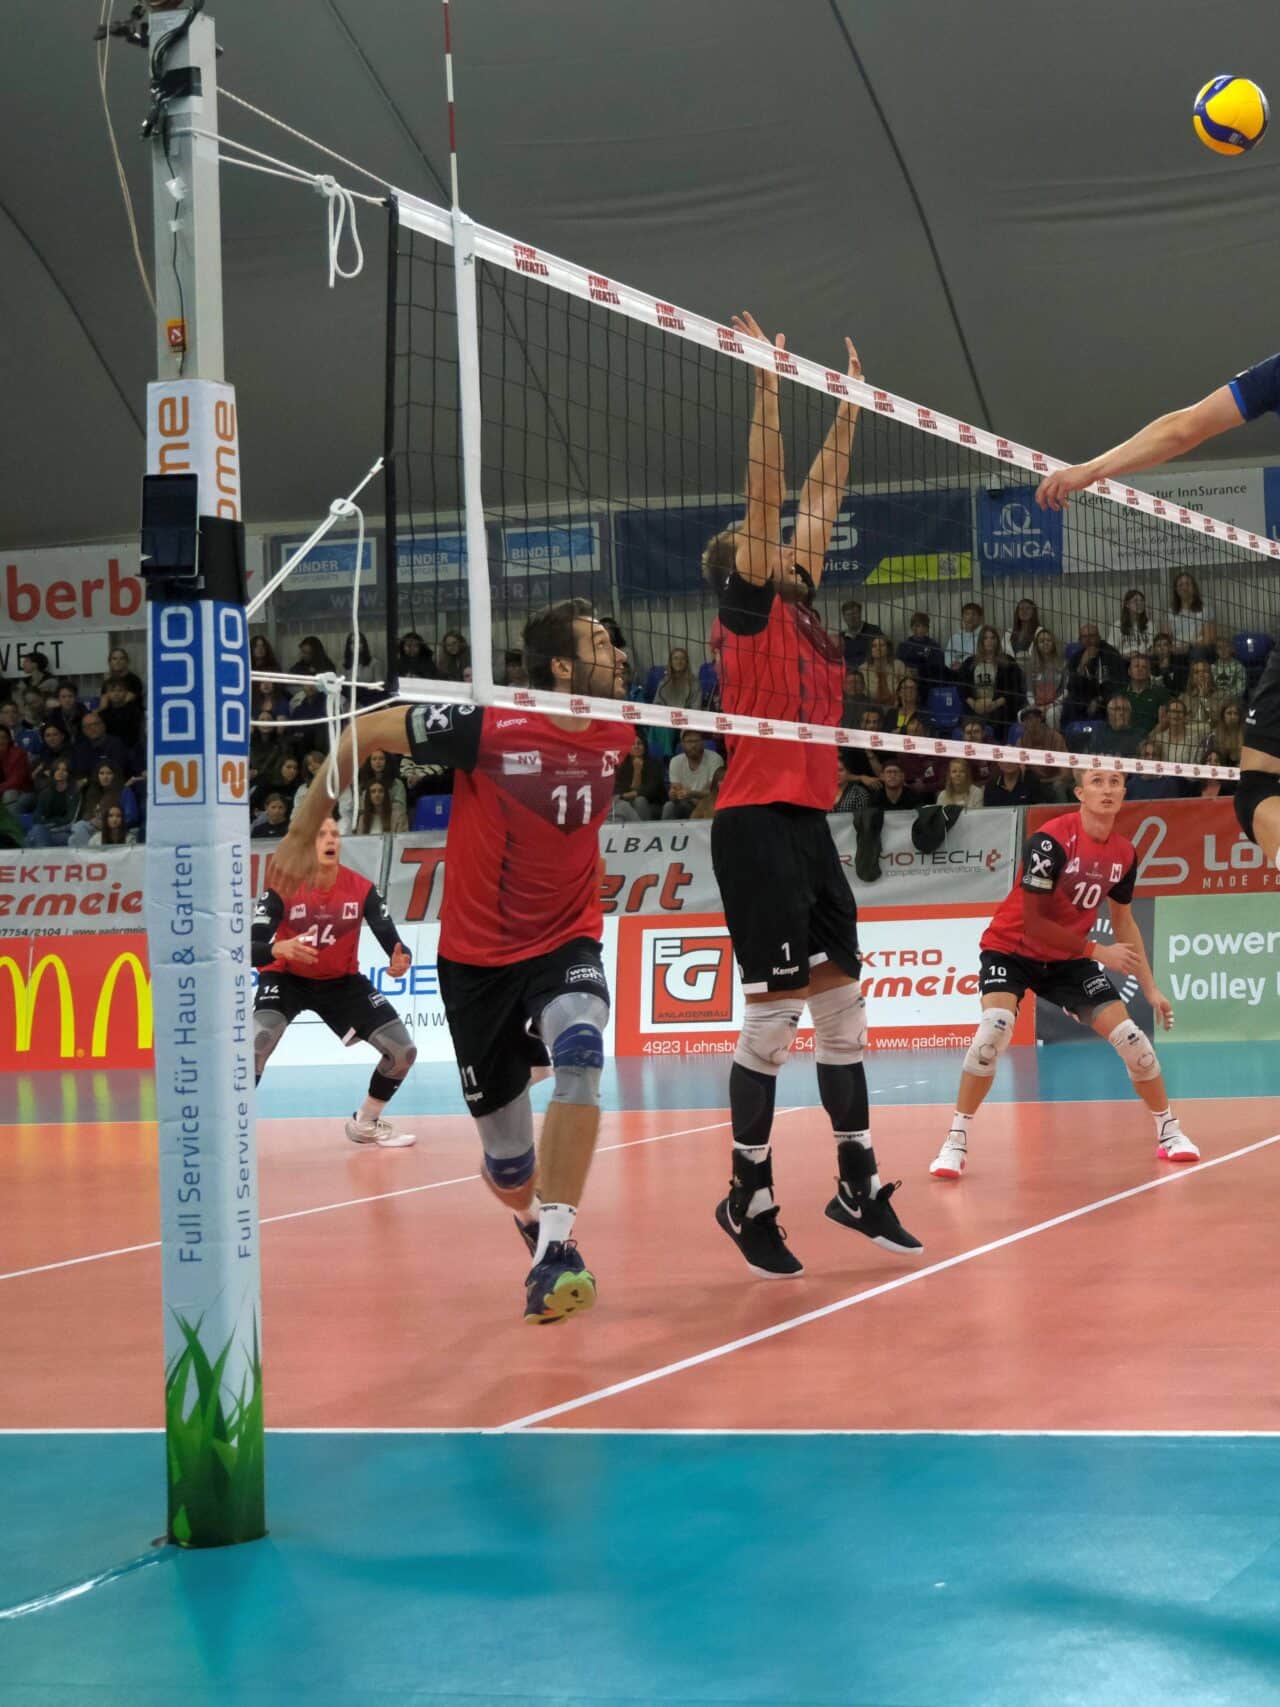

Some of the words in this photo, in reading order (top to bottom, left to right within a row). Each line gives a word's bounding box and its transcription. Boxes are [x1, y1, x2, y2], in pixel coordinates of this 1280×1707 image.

[158, 396, 190, 475] me
[214, 400, 238, 522] ome
[1177, 484, 1248, 498] InnSurance
[399, 552, 449, 566] BINDER
[511, 545, 561, 559] BINDER
[983, 540, 1055, 560] UNIQA
[160, 605, 196, 742] DUO
[218, 606, 246, 743] DUO
[551, 784, 592, 825] 11
[604, 835, 690, 854] LBAU
[170, 843, 194, 936] Garten
[229, 844, 244, 934] Garten
[1072, 881, 1102, 909] 10
[1202, 876, 1249, 889] MADE
[0, 927, 61, 937] 7754/2104
[171, 946, 195, 965] &
[230, 947, 245, 964] &
[781, 941, 791, 962] 1
[861, 949, 943, 967] KTRO
[988, 965, 1007, 977] 10
[262, 984, 279, 994] 14
[1169, 971, 1266, 1005] Volley
[173, 975, 197, 1046] Haus
[232, 975, 246, 1043] Haus
[657, 1010, 729, 1019] ANLAGENBAU
[642, 1040, 681, 1054] 4923
[685, 1039, 738, 1054] Lohnsbu
[174, 1056, 198, 1096] für
[233, 1054, 248, 1092] für
[176, 1104, 201, 1204] Service
[236, 1101, 250, 1200] Service
[177, 1213, 203, 1264] Full
[237, 1209, 252, 1259] Full
